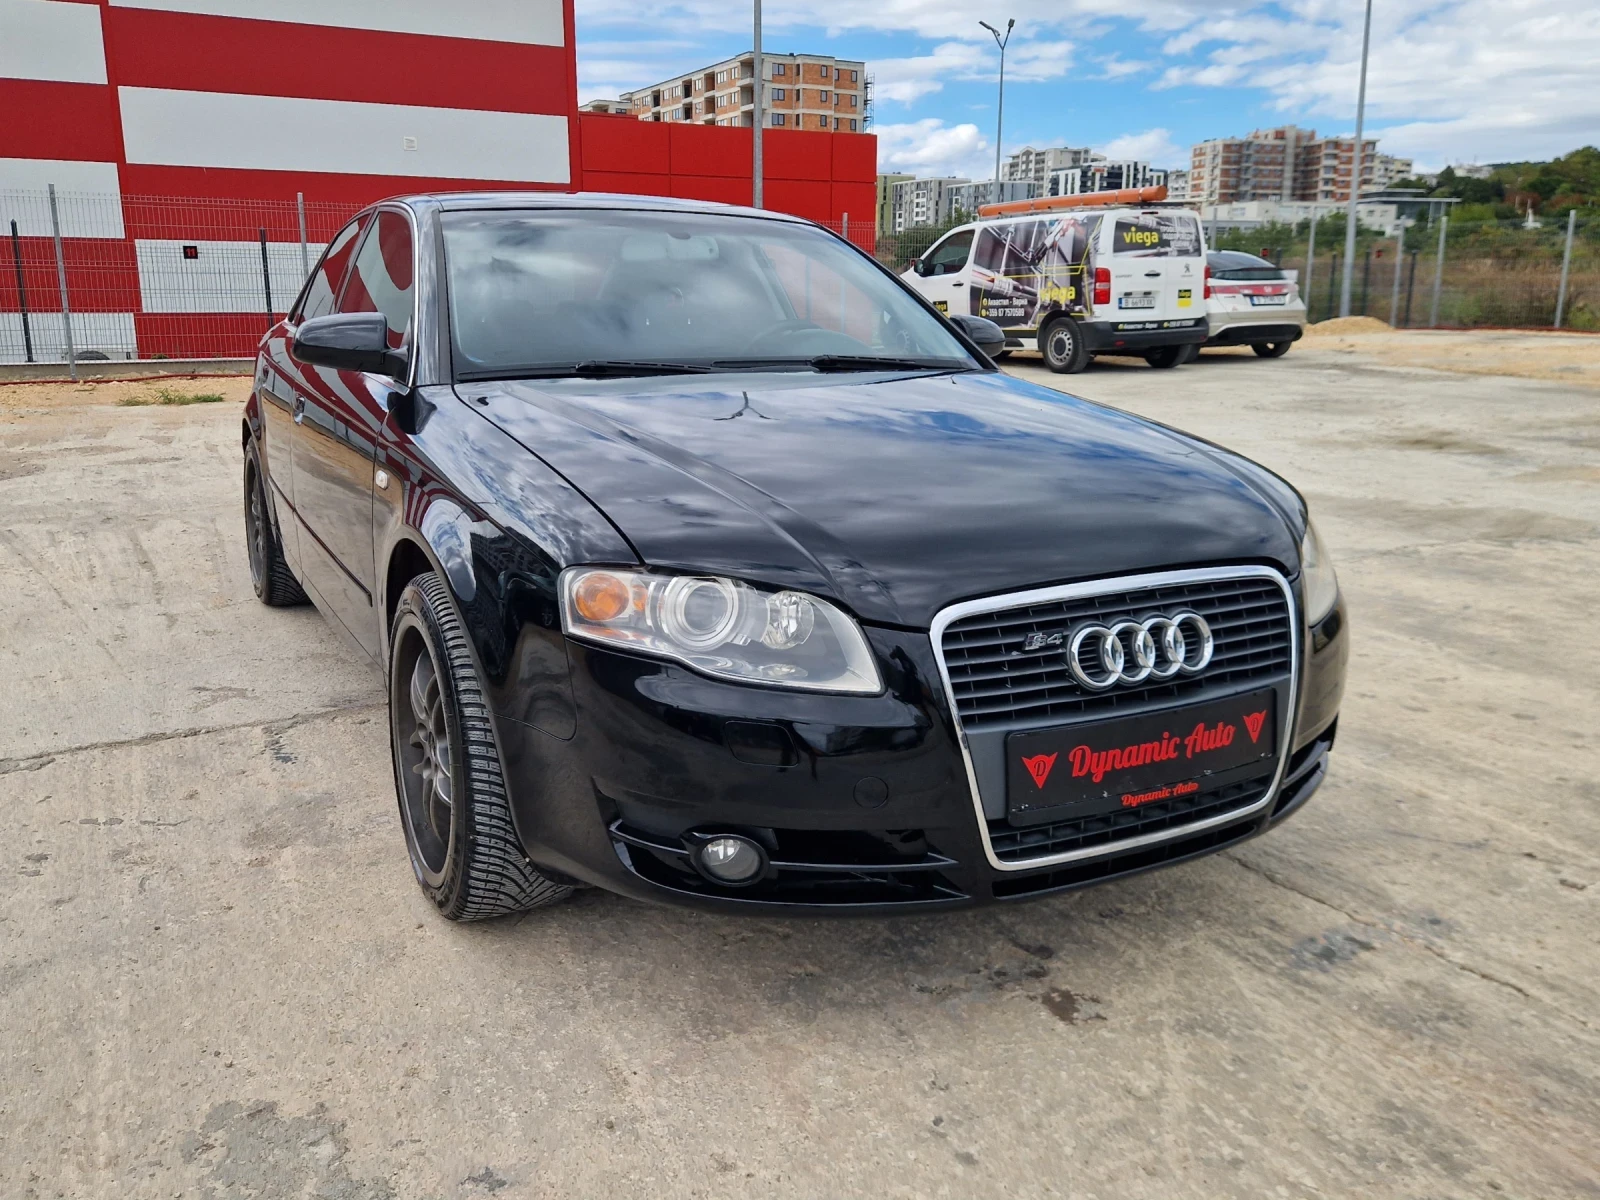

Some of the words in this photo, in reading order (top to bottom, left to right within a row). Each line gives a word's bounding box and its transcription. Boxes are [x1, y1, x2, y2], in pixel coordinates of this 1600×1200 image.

[1123, 226, 1159, 246] viega
[1040, 281, 1076, 304] viega
[1068, 731, 1181, 783] Dynamic
[1184, 721, 1236, 759] Auto
[1121, 786, 1171, 807] Dynamic
[1172, 781, 1199, 796] Auto
